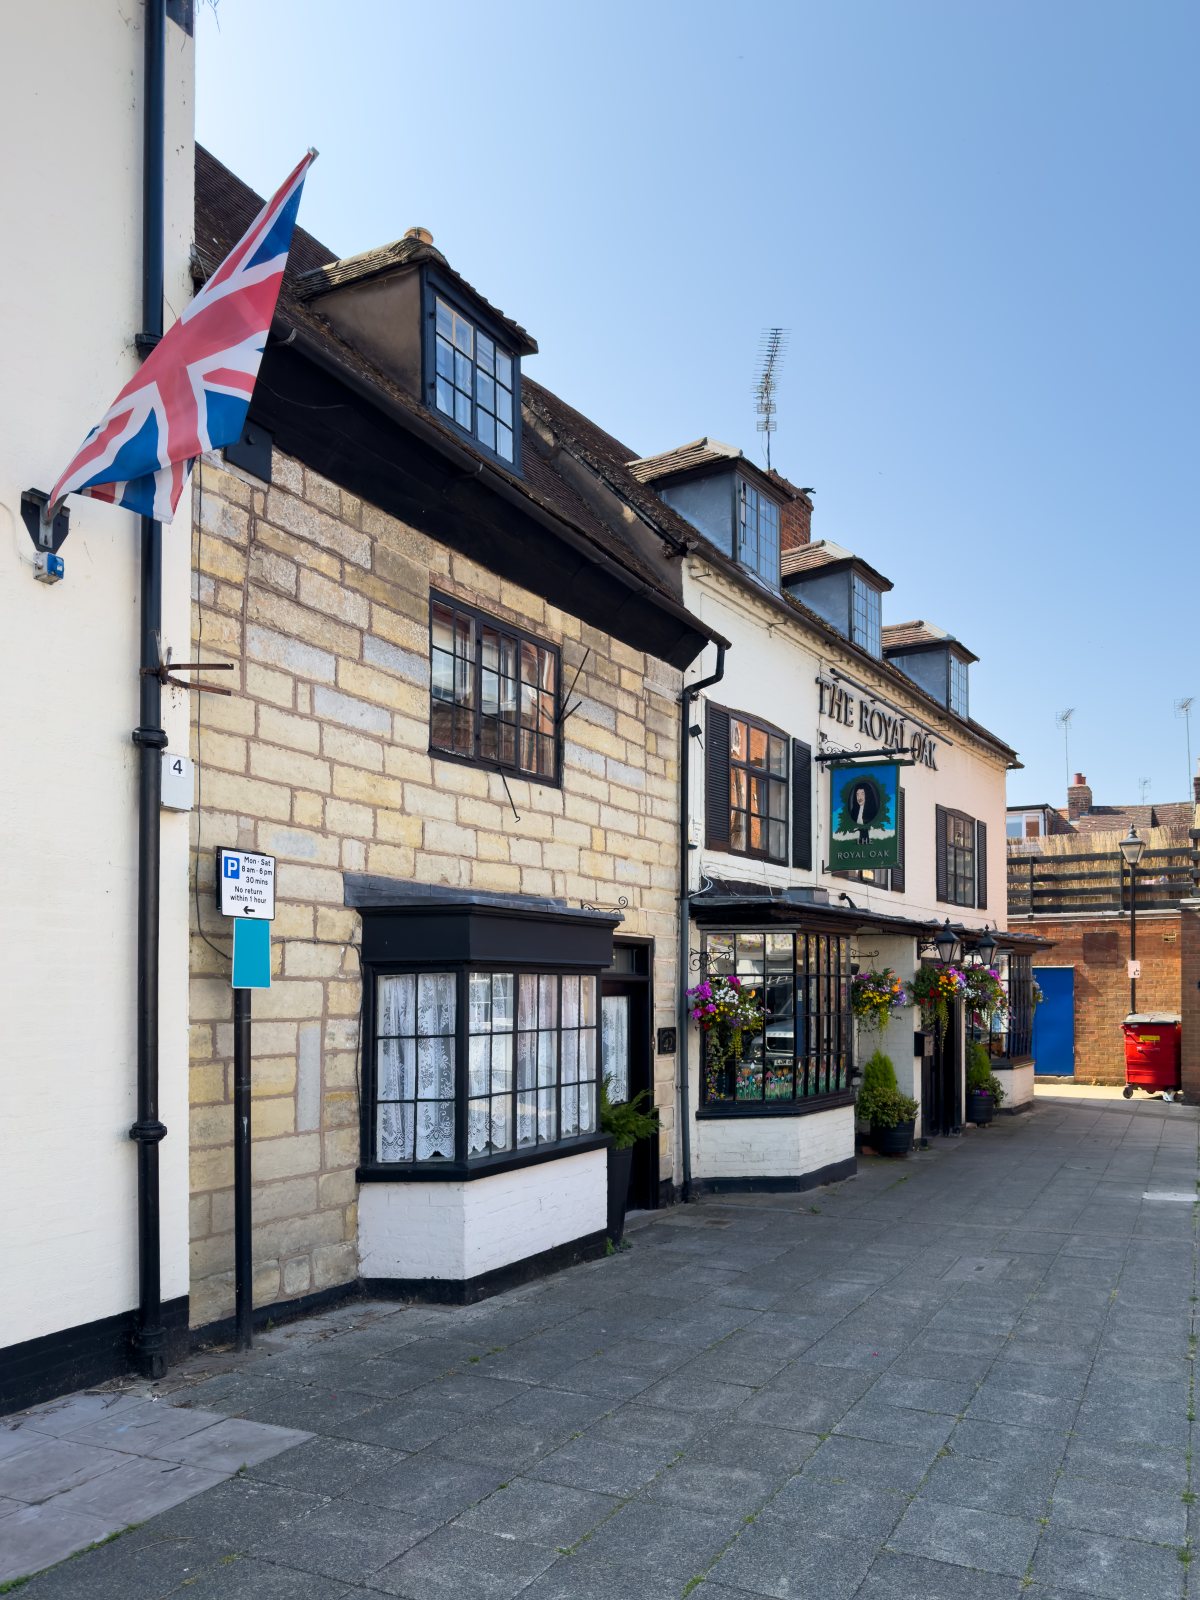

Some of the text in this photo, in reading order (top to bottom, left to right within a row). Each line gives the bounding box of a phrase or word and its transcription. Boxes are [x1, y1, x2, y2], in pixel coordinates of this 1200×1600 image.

[816, 677, 939, 772] THE ROYAL OAK
[173, 760, 183, 775] 4
[856, 837, 874, 845] THE
[244, 856, 256, 864] Mon
[837, 850, 889, 860] ROYAL OAK
